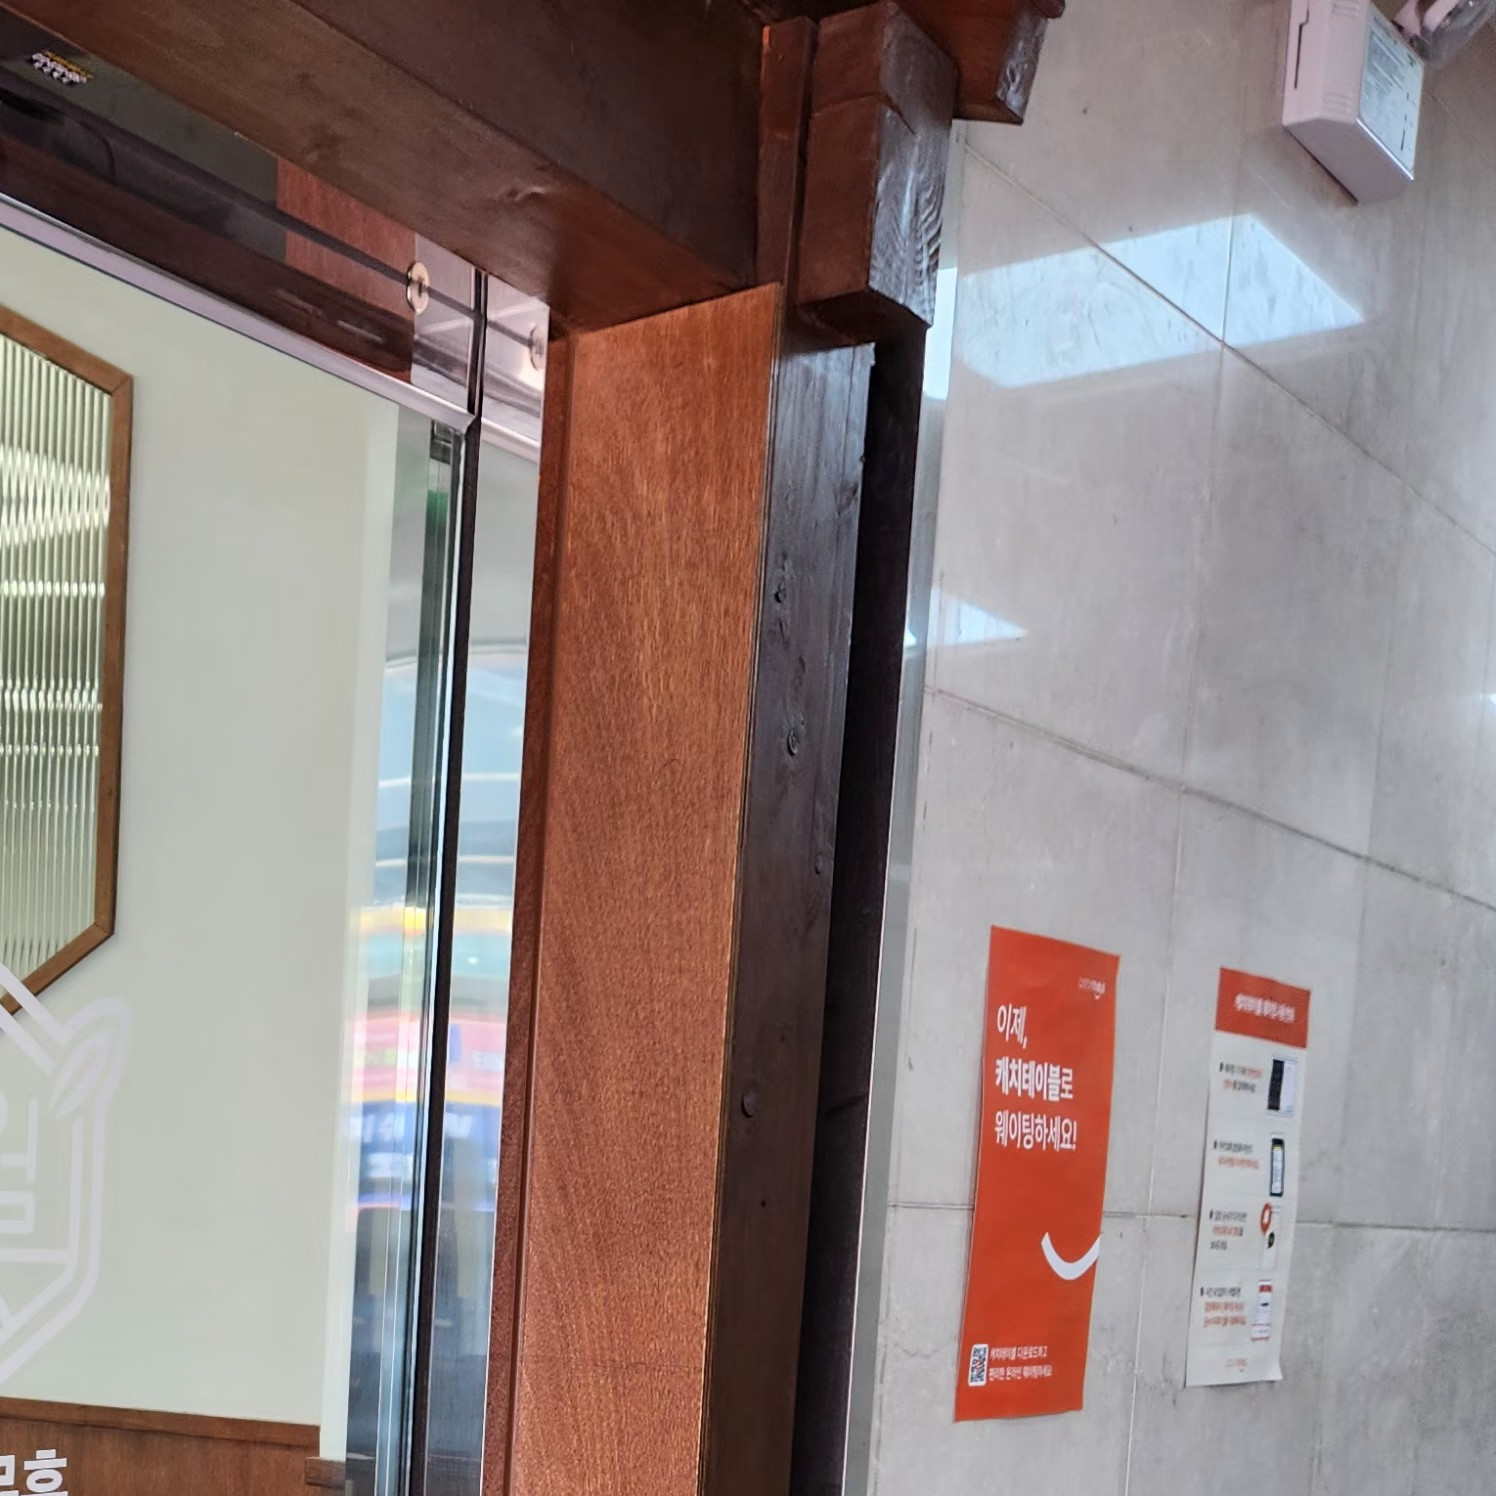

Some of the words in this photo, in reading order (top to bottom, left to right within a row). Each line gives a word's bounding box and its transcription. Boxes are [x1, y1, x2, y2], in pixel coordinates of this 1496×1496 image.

[996, 1003, 1028, 1049] 이제,
[995, 1056, 1074, 1102] 캐치테이블로
[994, 1109, 1077, 1152] 웨이팅하세요!
